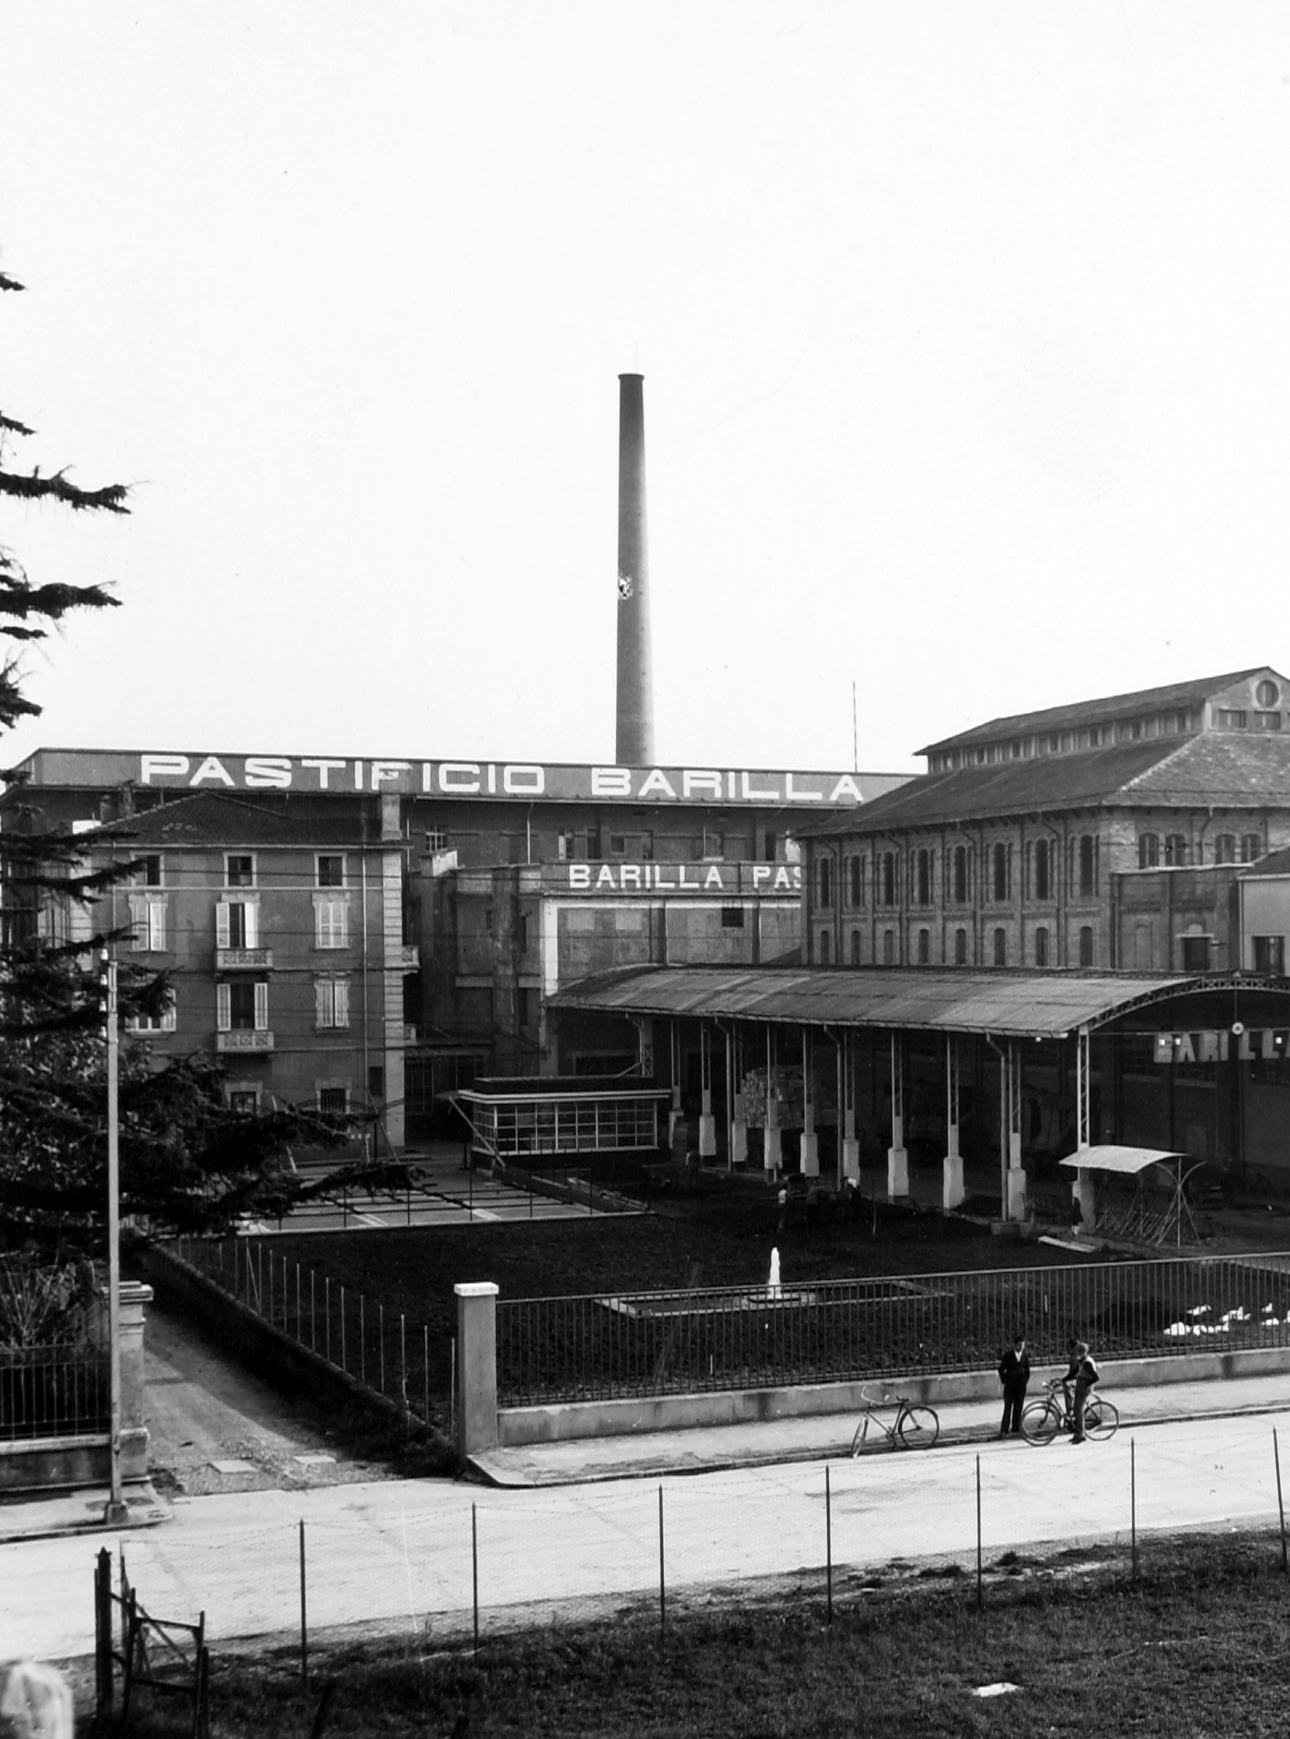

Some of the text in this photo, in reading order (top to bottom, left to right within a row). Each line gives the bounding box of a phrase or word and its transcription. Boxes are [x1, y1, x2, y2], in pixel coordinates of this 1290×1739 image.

[141, 754, 863, 801] PASTIFICIO BARILLA
[569, 864, 723, 888] BARILLA
